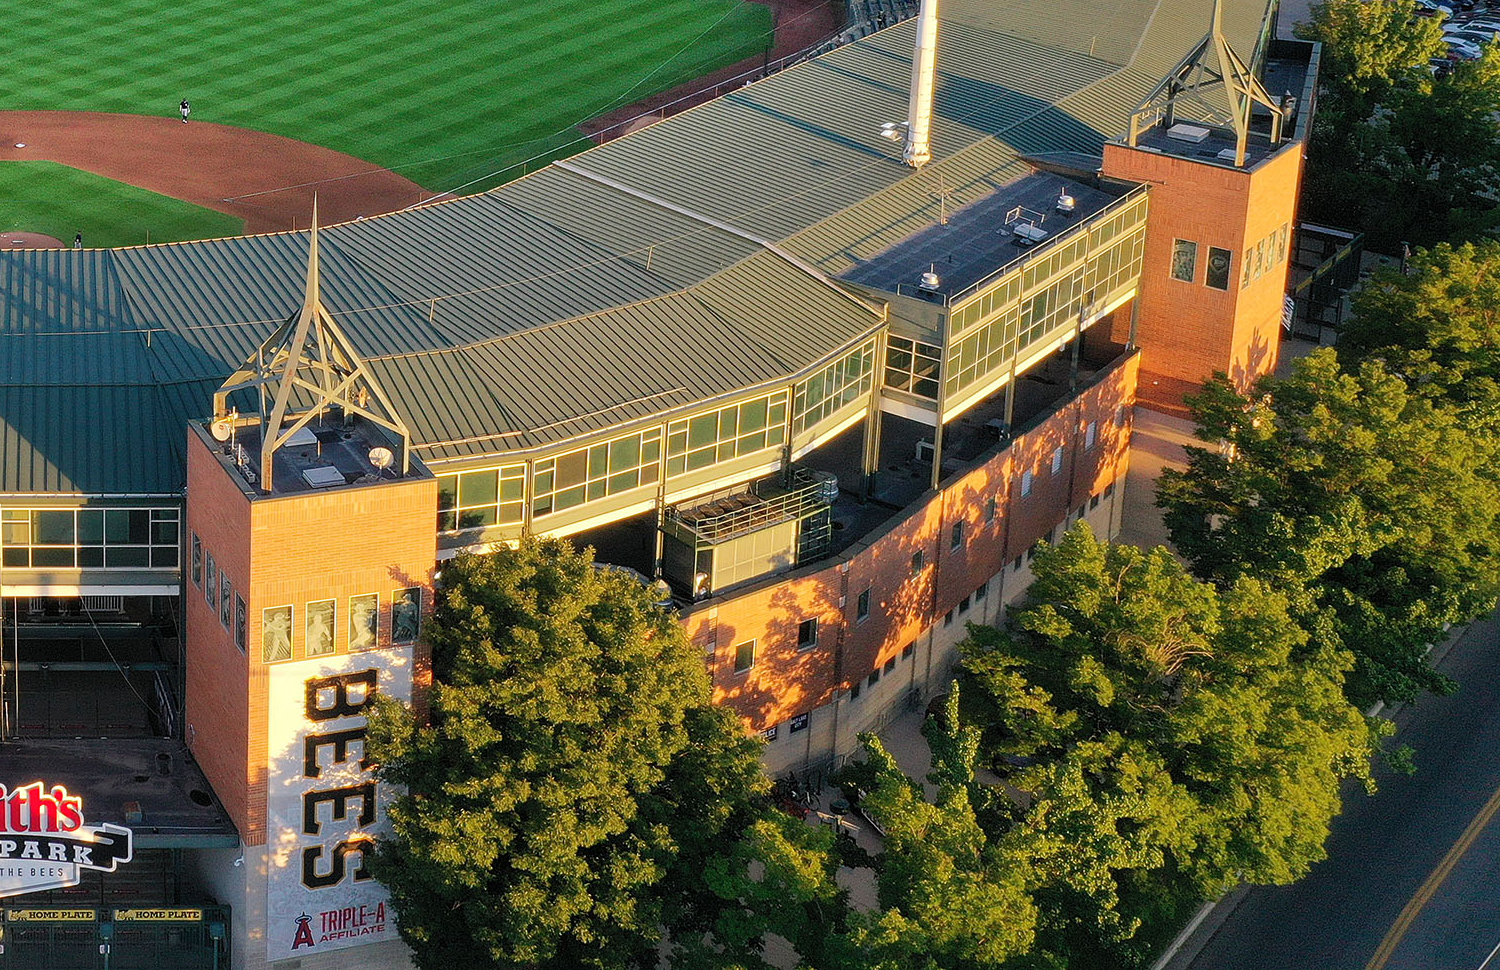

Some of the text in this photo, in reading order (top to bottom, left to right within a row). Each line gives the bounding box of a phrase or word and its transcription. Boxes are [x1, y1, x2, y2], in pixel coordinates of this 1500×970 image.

[301, 667, 379, 891] BEES
[0, 867, 26, 877] THE
[30, 867, 65, 877] BEES
[28, 911, 92, 919] HOME PLATE
[135, 911, 199, 919] HOME PLATE
[320, 902, 385, 932] TRIPLE-A
[319, 924, 385, 943] AFFILIATE
